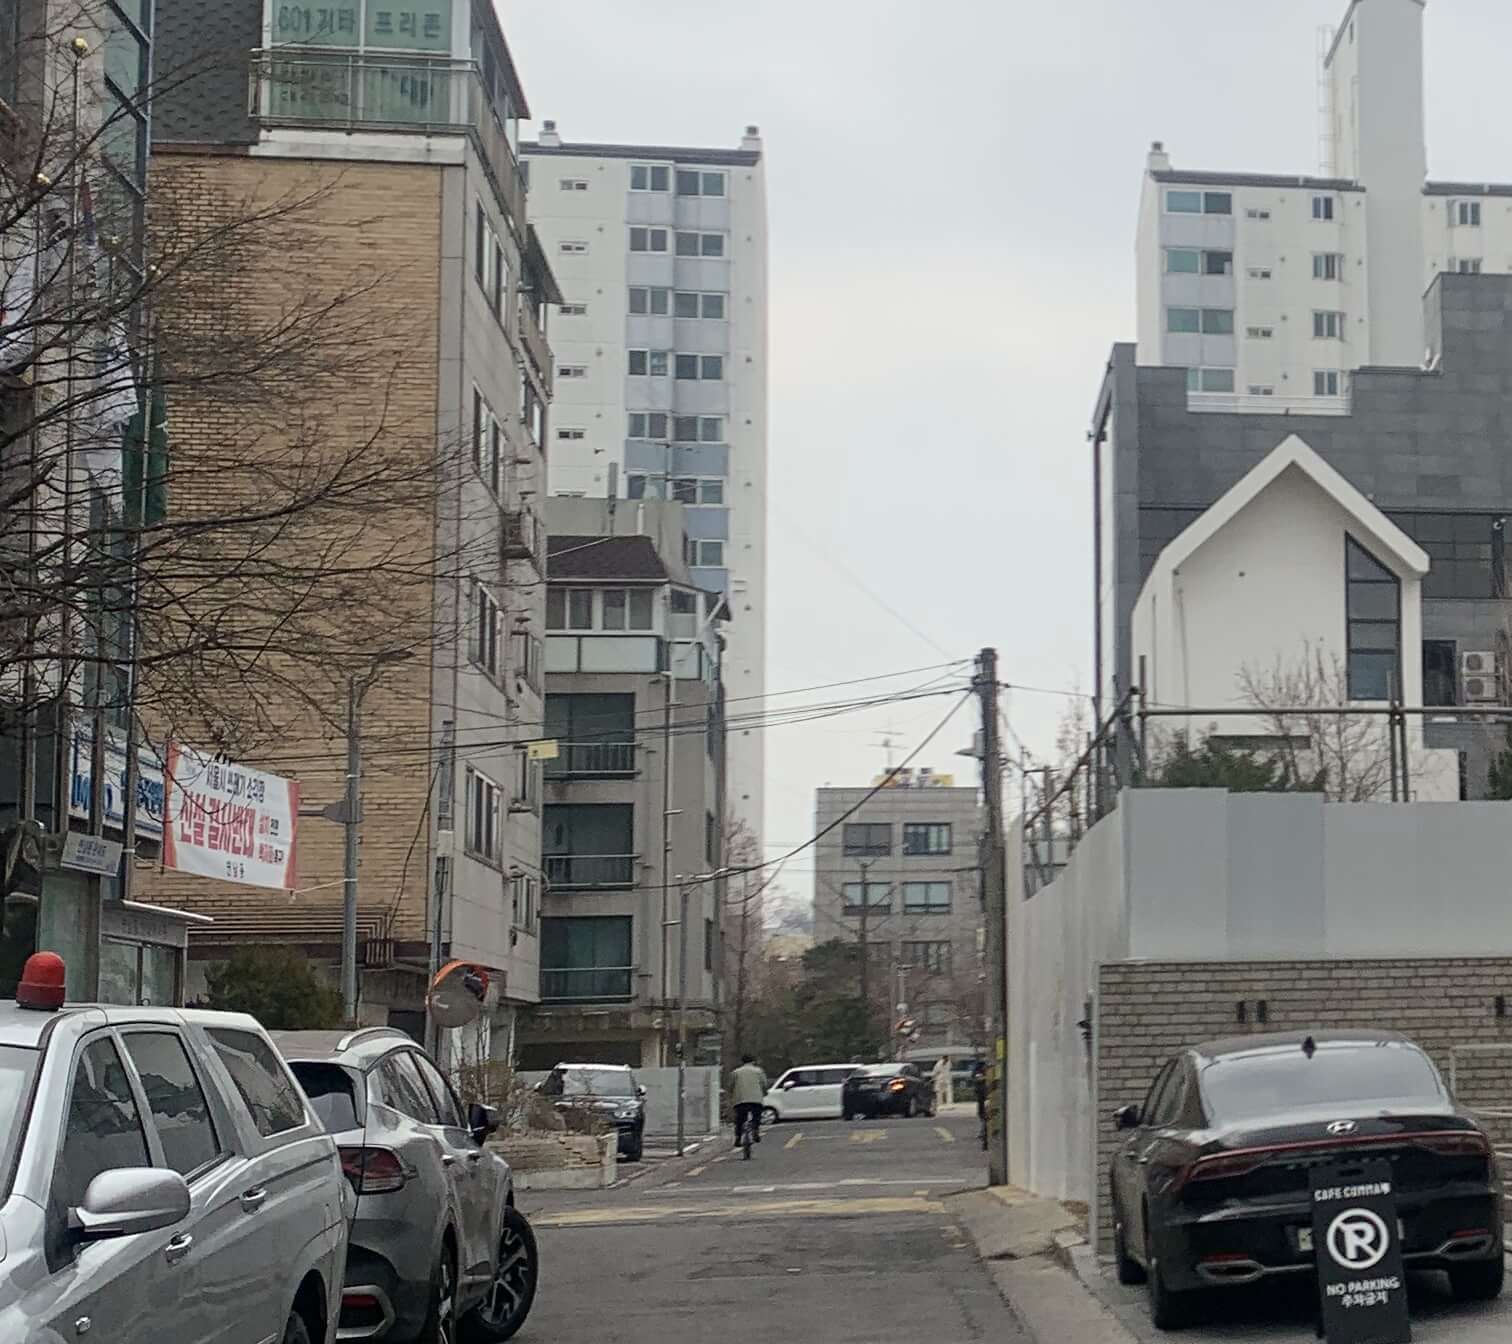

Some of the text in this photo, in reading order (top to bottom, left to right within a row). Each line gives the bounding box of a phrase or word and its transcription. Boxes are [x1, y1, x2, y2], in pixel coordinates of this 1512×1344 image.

[1314, 1186, 1343, 1201] CAFE
[1326, 1276, 1400, 1296] NO PARKING
[1341, 1290, 1389, 1308] 주차금지
